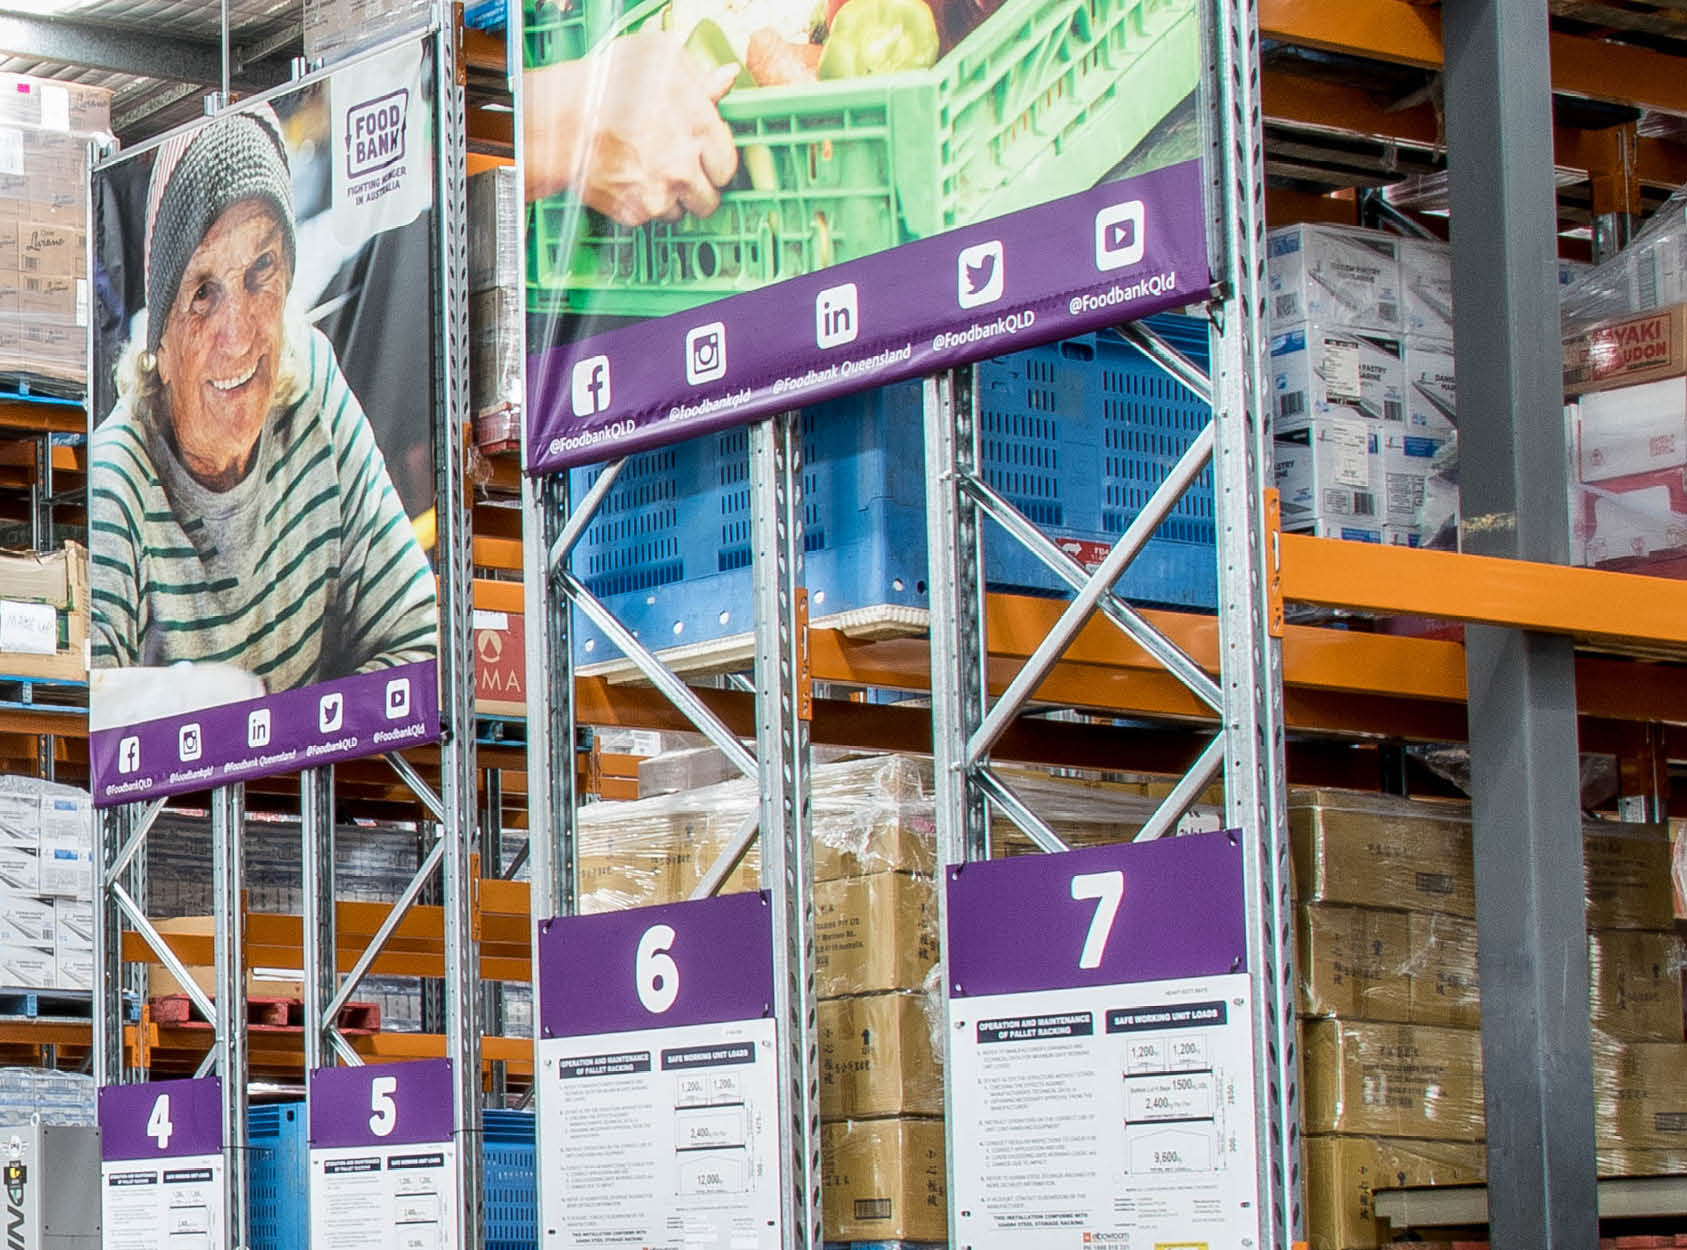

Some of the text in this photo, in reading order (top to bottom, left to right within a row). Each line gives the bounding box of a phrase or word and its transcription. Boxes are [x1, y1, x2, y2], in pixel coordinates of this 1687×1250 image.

[356, 105, 400, 139] FOOD
[356, 128, 399, 164] BANK
[1069, 272, 1176, 315] @FoodbankQld
[932, 310, 1035, 352] @FoodbankQLD
[773, 343, 911, 394] @Foodbank Queensland
[669, 388, 751, 422] @foodbankqld
[550, 420, 636, 455] @FoodbankQLD
[474, 667, 521, 692] MA
[306, 737, 358, 756] @FoodbankQLD
[1071, 870, 1124, 969] 7
[635, 924, 680, 1014] 6
[1114, 1016, 1134, 1025] SAFE
[147, 1094, 173, 1149] 4
[369, 1076, 397, 1137] 5
